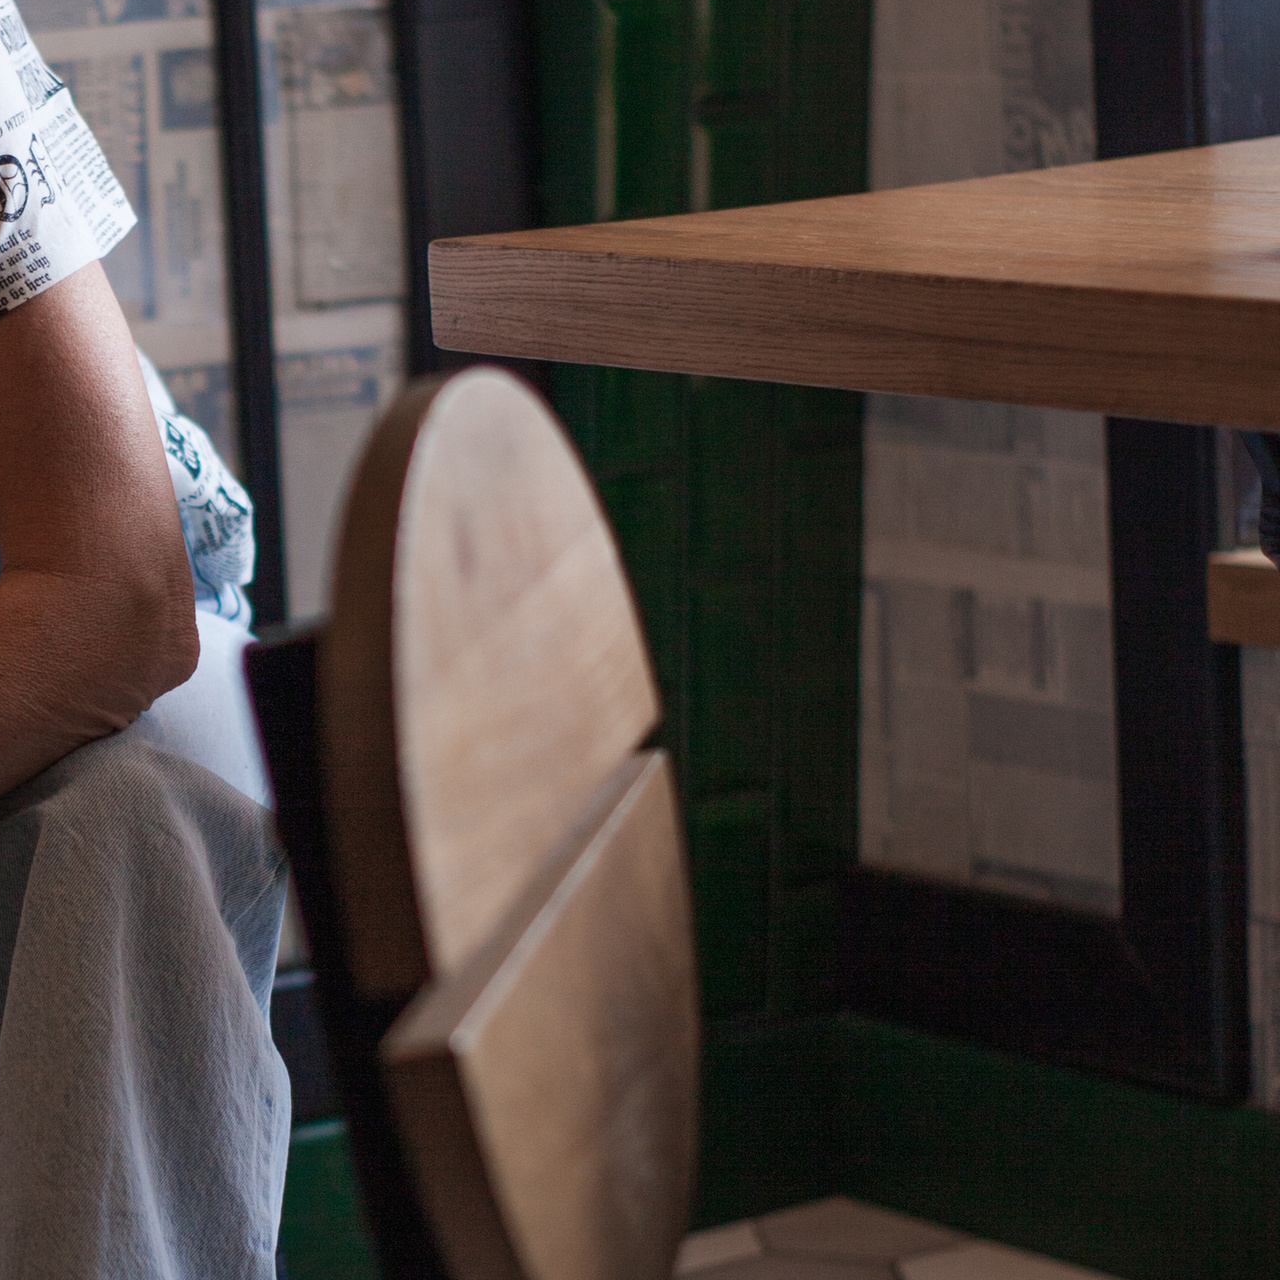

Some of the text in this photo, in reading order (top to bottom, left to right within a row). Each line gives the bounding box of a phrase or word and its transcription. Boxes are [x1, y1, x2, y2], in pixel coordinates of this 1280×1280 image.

[18, 226, 33, 242] be
[5, 246, 29, 267] and
[28, 240, 43, 255] do
[25, 254, 51, 276] why
[8, 284, 27, 301] be
[25, 271, 53, 292] here
